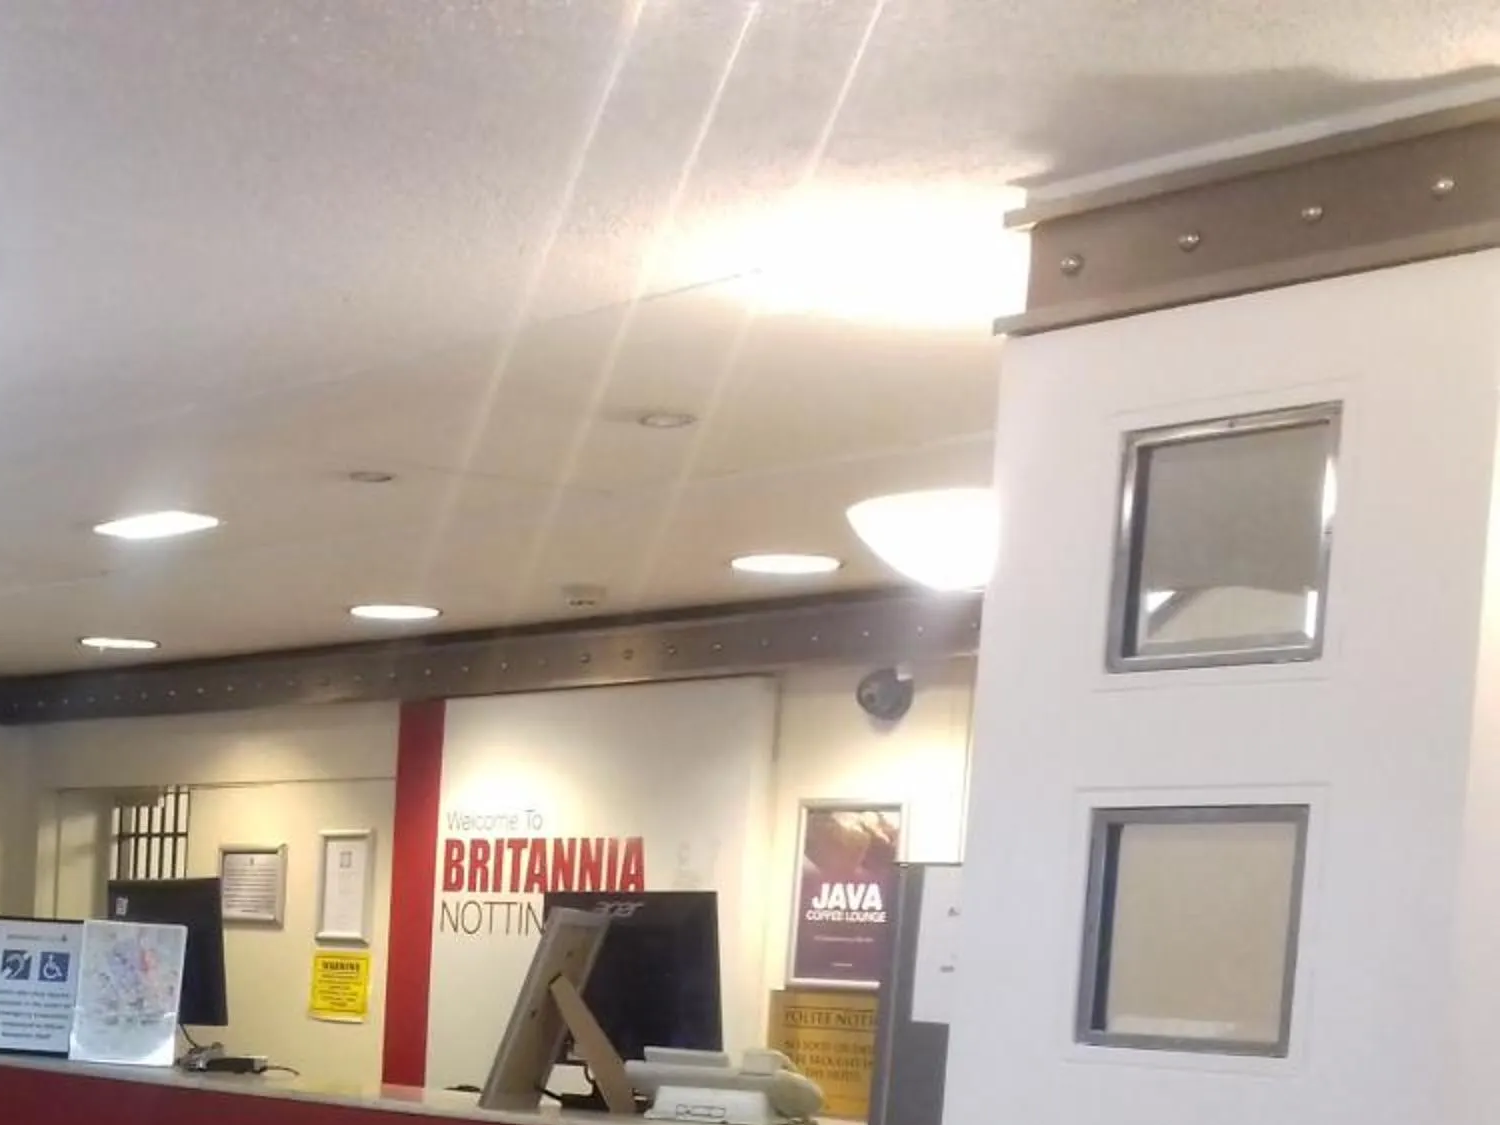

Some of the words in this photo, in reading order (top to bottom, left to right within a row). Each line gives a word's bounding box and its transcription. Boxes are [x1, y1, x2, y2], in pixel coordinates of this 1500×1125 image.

[446, 809, 519, 831] Welcome
[523, 809, 544, 831] To
[442, 837, 646, 894] BRITANNIA
[811, 882, 883, 911] JAVA
[806, 909, 843, 922] COFFEE
[845, 911, 887, 923] LOUNGE
